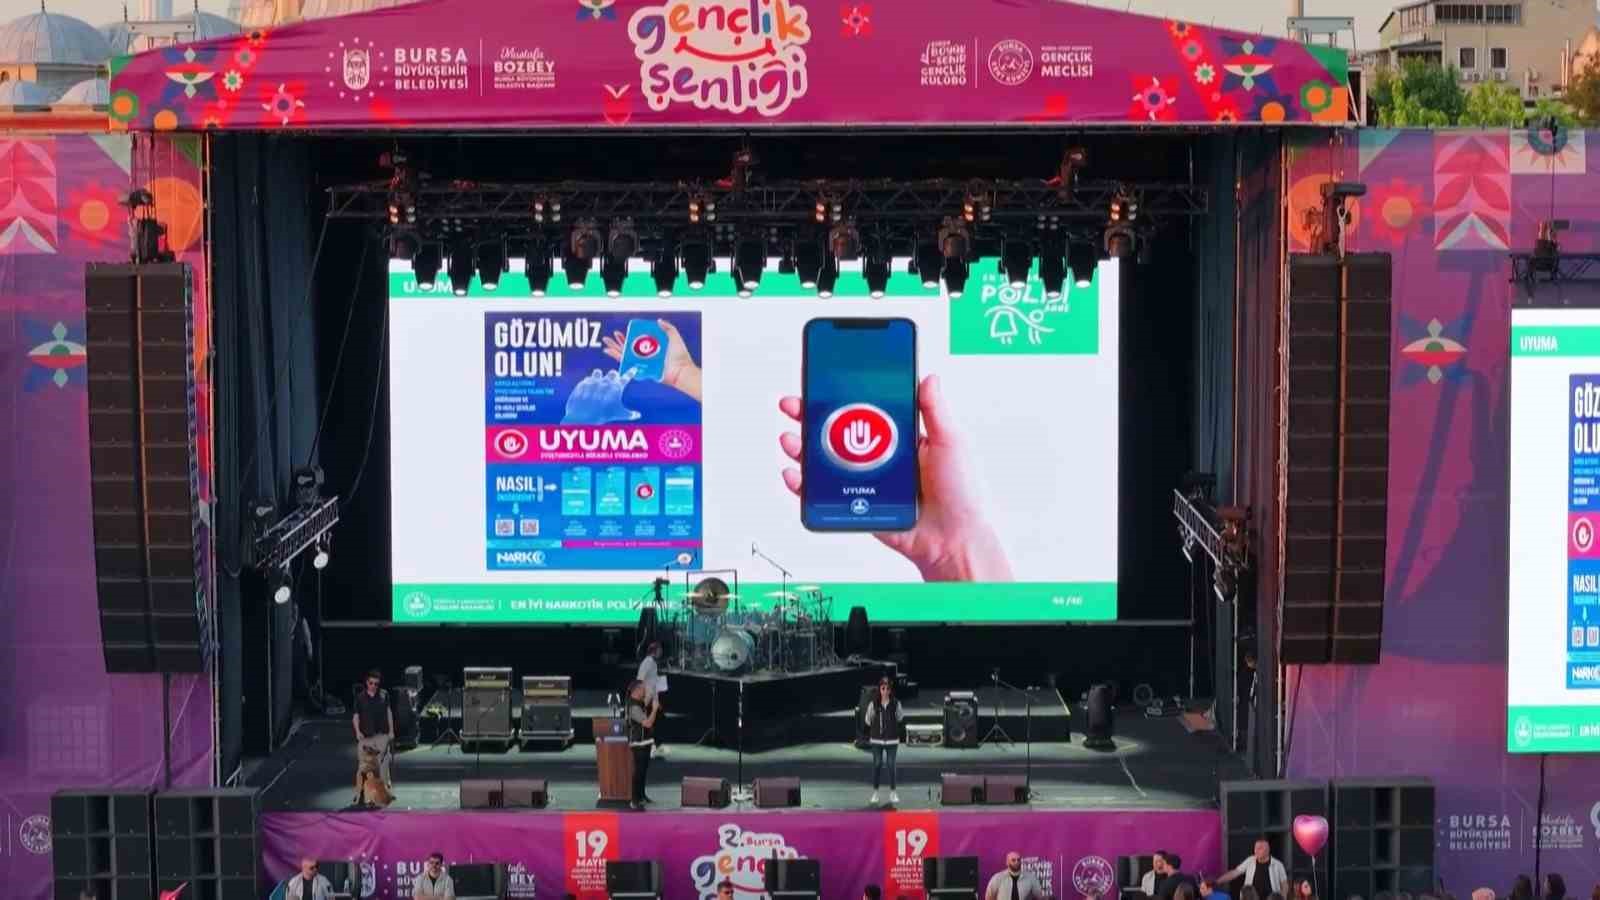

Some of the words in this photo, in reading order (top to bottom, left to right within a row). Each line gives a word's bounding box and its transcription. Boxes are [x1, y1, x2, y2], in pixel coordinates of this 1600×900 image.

[636, 0, 805, 55] gençlik
[394, 47, 468, 63] BURSA
[1041, 51, 1093, 64] GENÇLİK
[394, 63, 468, 77] BÜYÜKŞEHİR
[494, 61, 555, 73] BOZBEY
[1041, 64, 1093, 77] MECLİSİ
[394, 76, 468, 90] BELEDİYESİ
[649, 53, 802, 109] şenliği
[495, 318, 602, 349] GÖZÜMÜZ
[1519, 336, 1559, 352] UYUMA
[495, 351, 562, 377] OLUN!
[539, 429, 649, 450] UYUMA
[496, 476, 537, 492] NASIL
[842, 487, 876, 495] UYUMA
[1573, 574, 1598, 592] NASIL
[1449, 815, 1512, 828] BURSA
[576, 829, 608, 857] 19
[724, 829, 744, 848] 2.
[896, 828, 929, 857] 19
